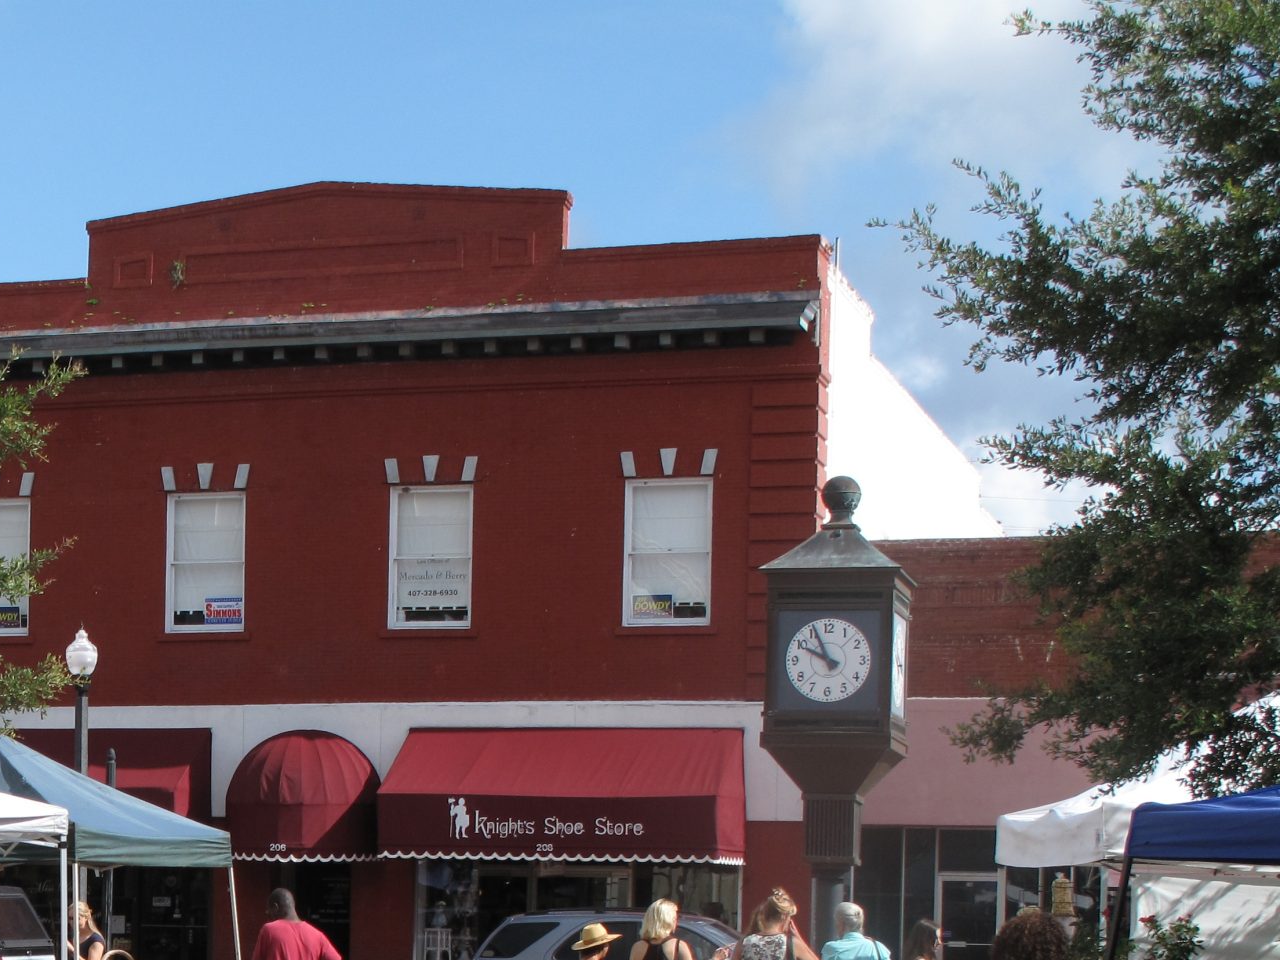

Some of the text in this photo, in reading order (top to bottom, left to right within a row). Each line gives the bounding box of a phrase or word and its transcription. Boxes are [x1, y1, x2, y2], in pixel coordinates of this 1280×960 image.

[399, 570, 433, 581] Mercado
[445, 570, 467, 581] Berry
[634, 601, 670, 610] DOWDY
[823, 623, 834, 634] 12
[842, 628, 847, 638] 1
[796, 639, 808, 650] 10
[853, 639, 861, 649] 2
[791, 655, 799, 666] 9
[859, 655, 866, 665] 3
[796, 671, 805, 683] 8
[852, 671, 860, 683] 4
[809, 682, 817, 693] 7
[823, 686, 831, 697] 6
[839, 682, 847, 693] 5
[473, 809, 645, 839] Knight's Shoe Store
[269, 842, 287, 852] 206
